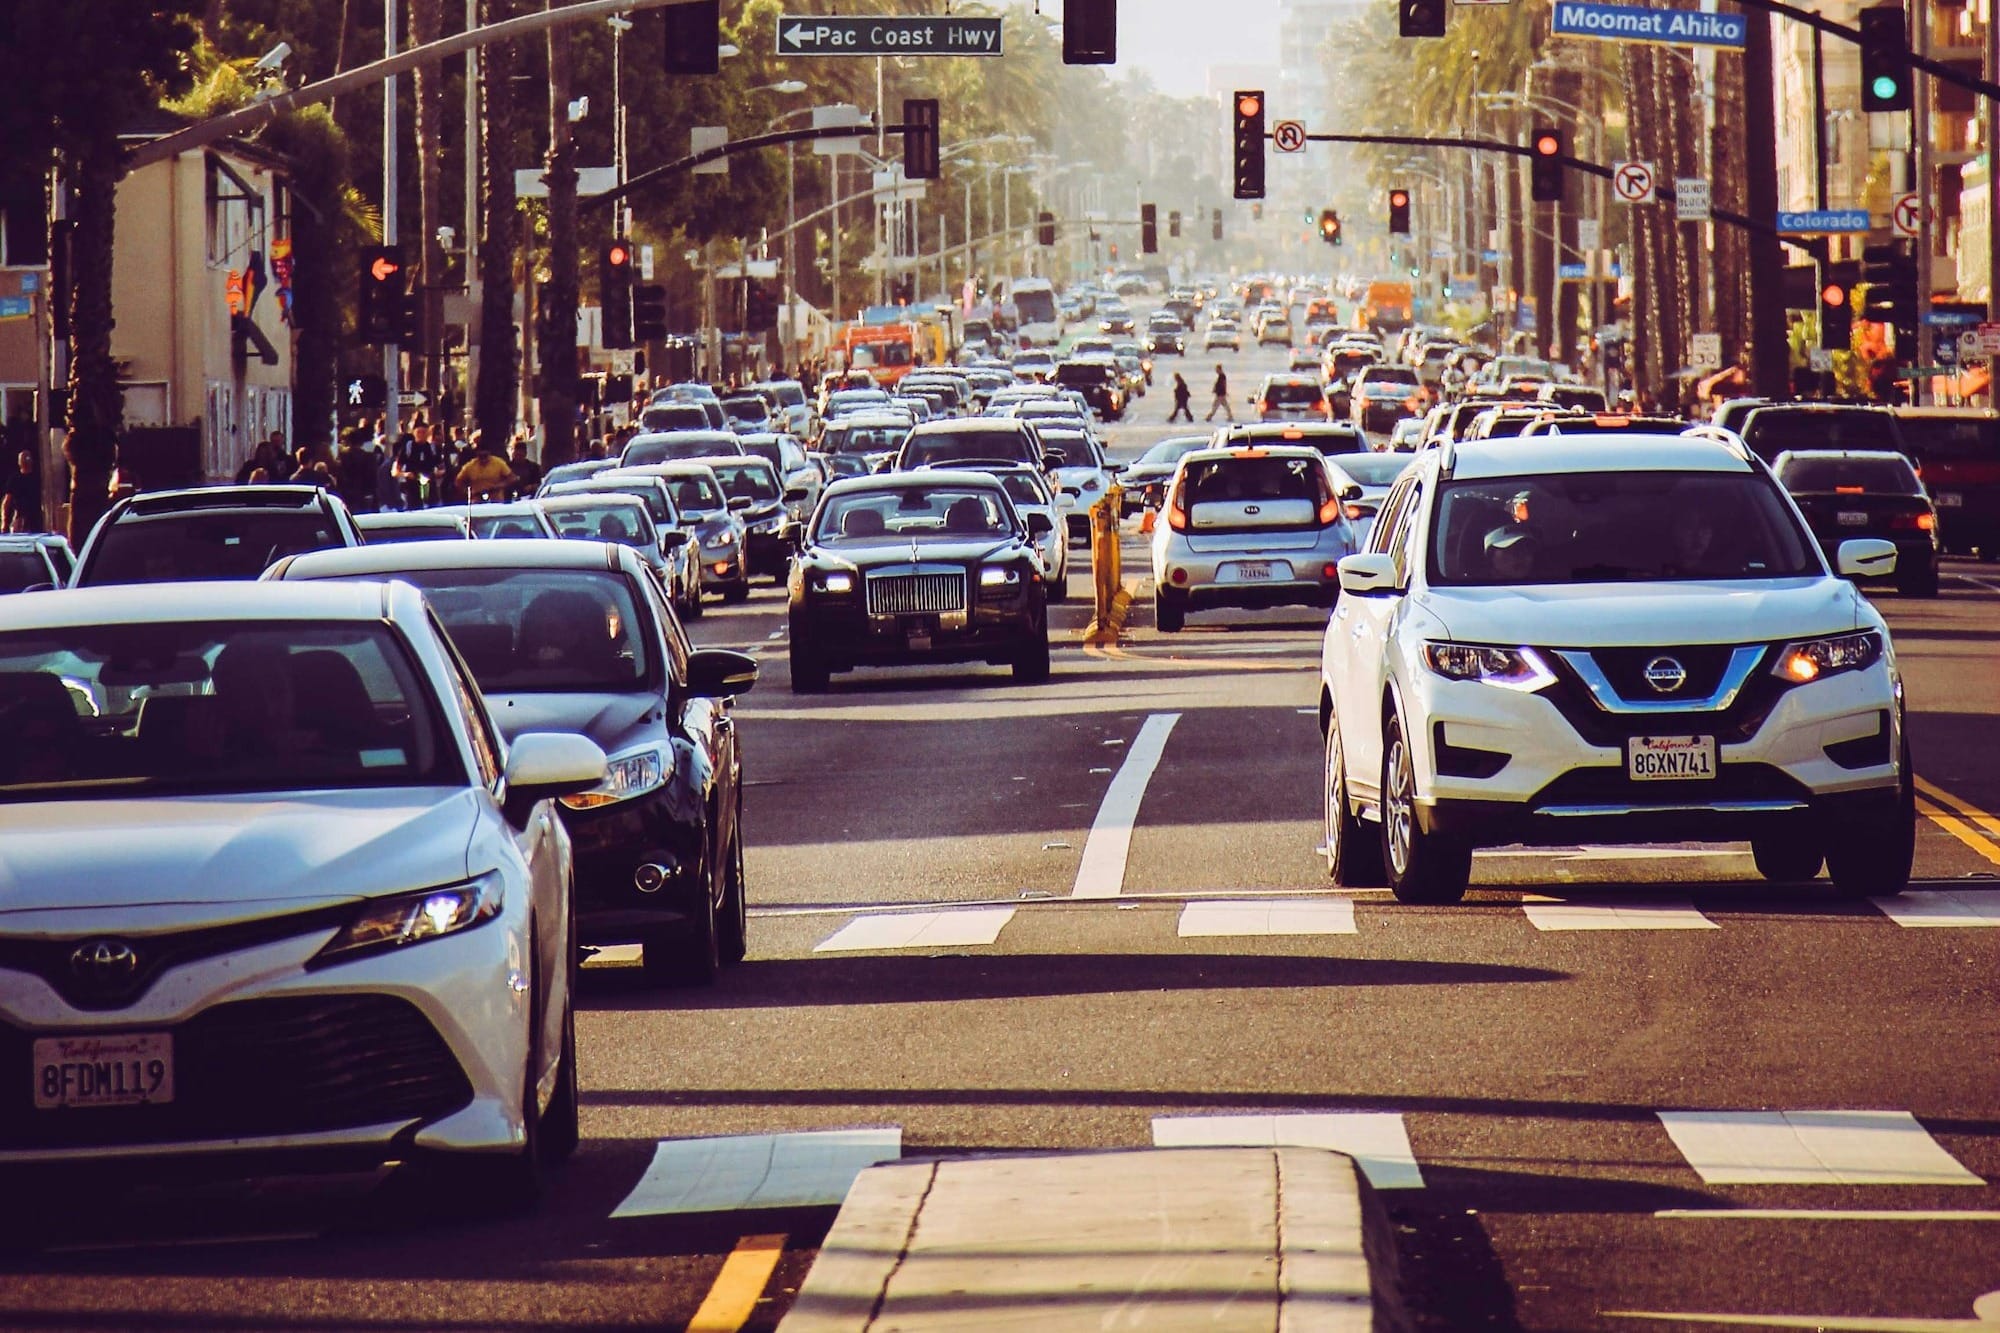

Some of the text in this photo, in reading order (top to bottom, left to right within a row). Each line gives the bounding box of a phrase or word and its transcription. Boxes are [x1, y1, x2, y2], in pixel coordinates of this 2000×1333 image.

[1561, 6, 1740, 40] Moomat Ahiko
[815, 26, 997, 50] Pac Coast Hwy
[1781, 213, 1866, 229] Colorado
[1647, 739, 1694, 752] California
[1635, 752, 1710, 774] 8GXN741
